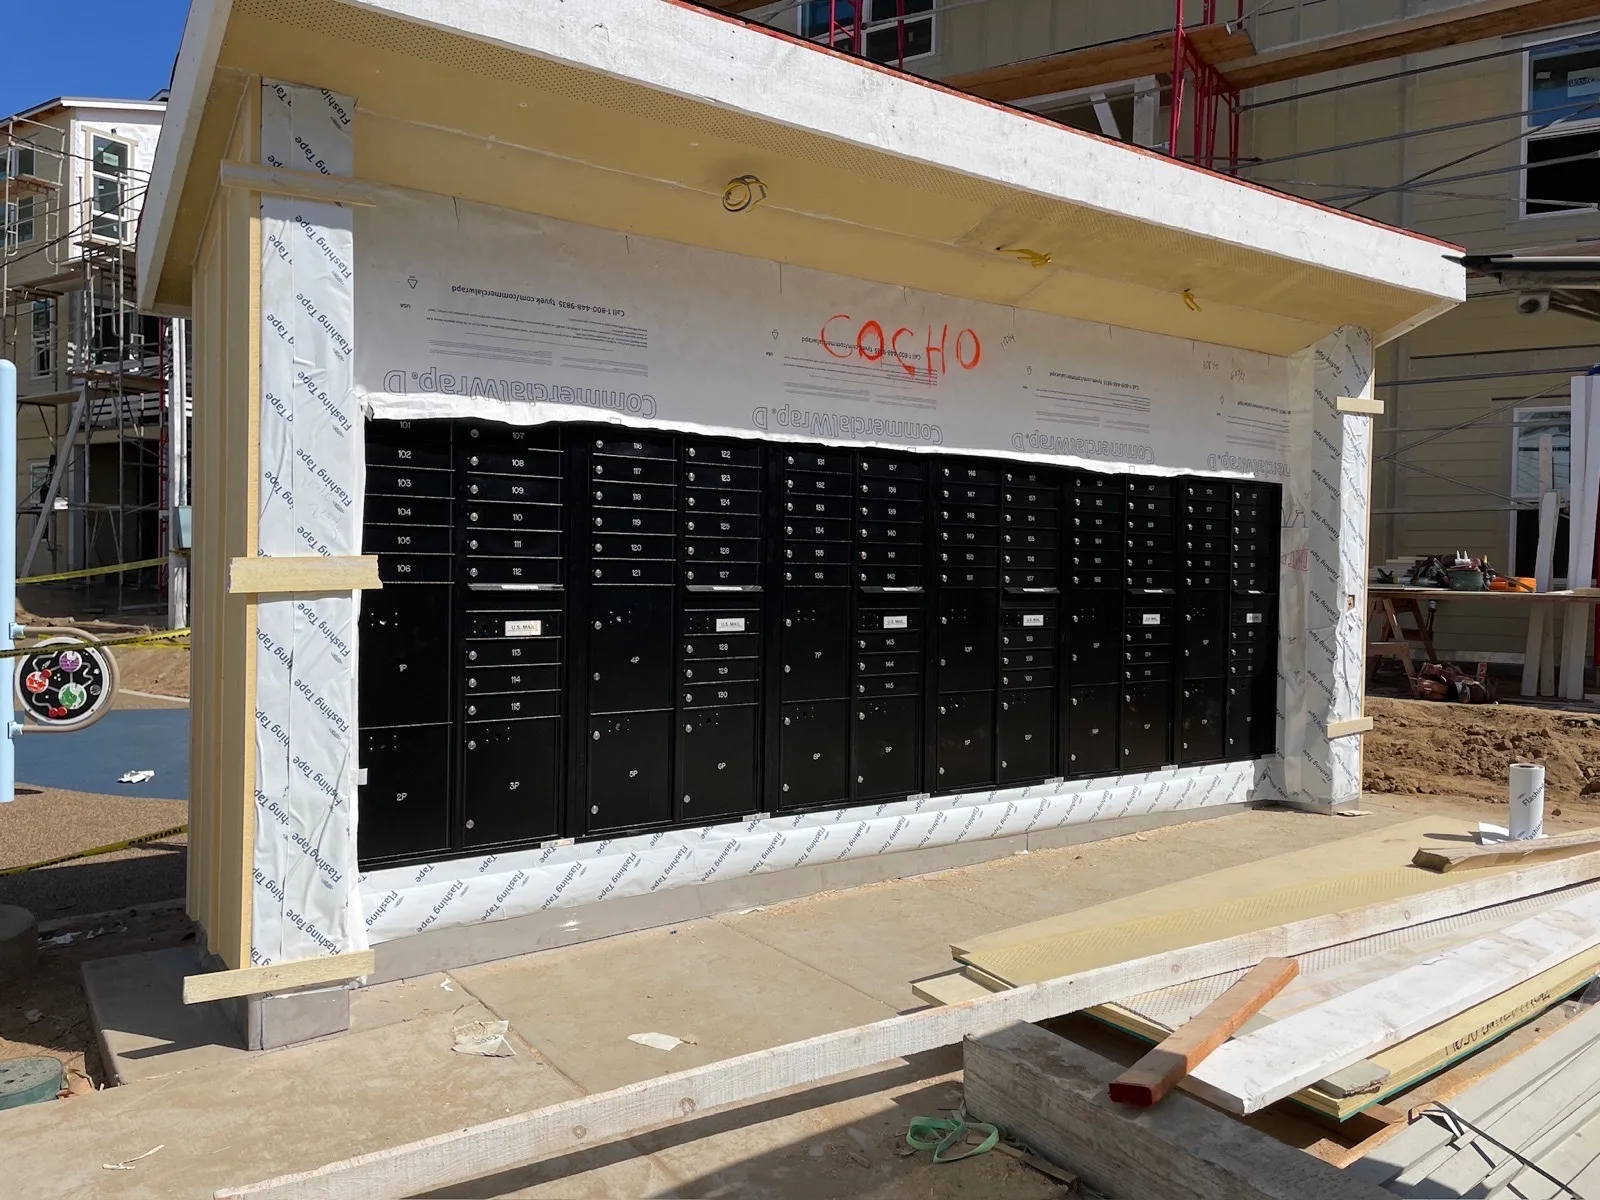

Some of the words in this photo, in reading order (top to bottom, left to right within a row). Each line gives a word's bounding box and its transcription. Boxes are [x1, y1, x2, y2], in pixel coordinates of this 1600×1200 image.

[294, 136, 318, 164] Tape
[294, 215, 314, 241] Tape
[268, 235, 287, 261] Tape
[316, 237, 352, 280] Flashing
[296, 293, 317, 317] Tape
[558, 299, 611, 316] 1-800-448-9835
[612, 308, 625, 317] Call
[266, 313, 287, 339] Tape
[316, 315, 352, 355] Flashing
[820, 313, 981, 382] COCHO
[297, 370, 317, 394] Tape
[383, 369, 407, 396] D
[265, 392, 286, 417] Tape
[317, 392, 352, 432] Flashing
[399, 420, 412, 430] 101
[752, 406, 768, 430] D
[511, 431, 526, 441] 107
[296, 448, 316, 473] Tape
[397, 449, 412, 460] 102
[720, 449, 732, 459] 122
[511, 458, 525, 468] 108
[632, 467, 643, 476] 117
[720, 473, 732, 483] 123
[264, 470, 286, 496] Tape
[316, 469, 352, 507] Flashing
[397, 477, 413, 488] 103
[511, 485, 525, 495] 109
[631, 492, 643, 502] 118
[719, 498, 731, 507] 124
[396, 507, 412, 517] 104
[511, 512, 524, 522] 110
[631, 518, 642, 527] 119
[719, 522, 731, 531] 125
[296, 526, 317, 550] Tape
[396, 535, 412, 545] 105
[513, 539, 523, 549] 111
[630, 543, 643, 552] 120
[719, 546, 731, 555] 126
[396, 563, 412, 573] 106
[511, 567, 523, 577] 112
[631, 568, 642, 578] 121
[718, 570, 730, 579] 127
[298, 602, 317, 626] Tape
[318, 621, 351, 658] Flashing
[718, 642, 729, 651] 128
[511, 648, 523, 657] 113
[629, 655, 641, 664] 4P
[398, 663, 408, 673] 1P
[717, 666, 729, 675] 129
[510, 675, 522, 684] 114
[294, 678, 314, 702] Tape
[717, 690, 729, 699] 130
[510, 701, 521, 712] 115
[314, 697, 350, 733] Flashing
[292, 756, 313, 778] Tape
[628, 769, 639, 779] 5P
[717, 761, 727, 771] 6P
[508, 780, 521, 791] 3P
[396, 791, 408, 802] 2P
[806, 826, 826, 854] Flashing
[849, 820, 868, 847] Flashing
[292, 832, 311, 854] Tape
[761, 832, 783, 860] Flashing
[664, 844, 688, 875] Flashing
[714, 838, 738, 868] Flashing
[794, 852, 809, 868] Tape
[836, 846, 852, 860] Tape
[612, 852, 637, 884] Flashing
[700, 867, 717, 882] Tape
[748, 860, 764, 874] Tape
[556, 860, 582, 893] Flashing
[650, 874, 667, 892] Tape
[497, 870, 524, 903] Flashing
[597, 883, 615, 901] Tape
[433, 880, 464, 914] Flashing
[541, 894, 560, 910] Tape
[366, 890, 398, 927] Flashing
[481, 902, 500, 921] Tape
[286, 908, 306, 930] Tape
[416, 915, 437, 933] Tape
